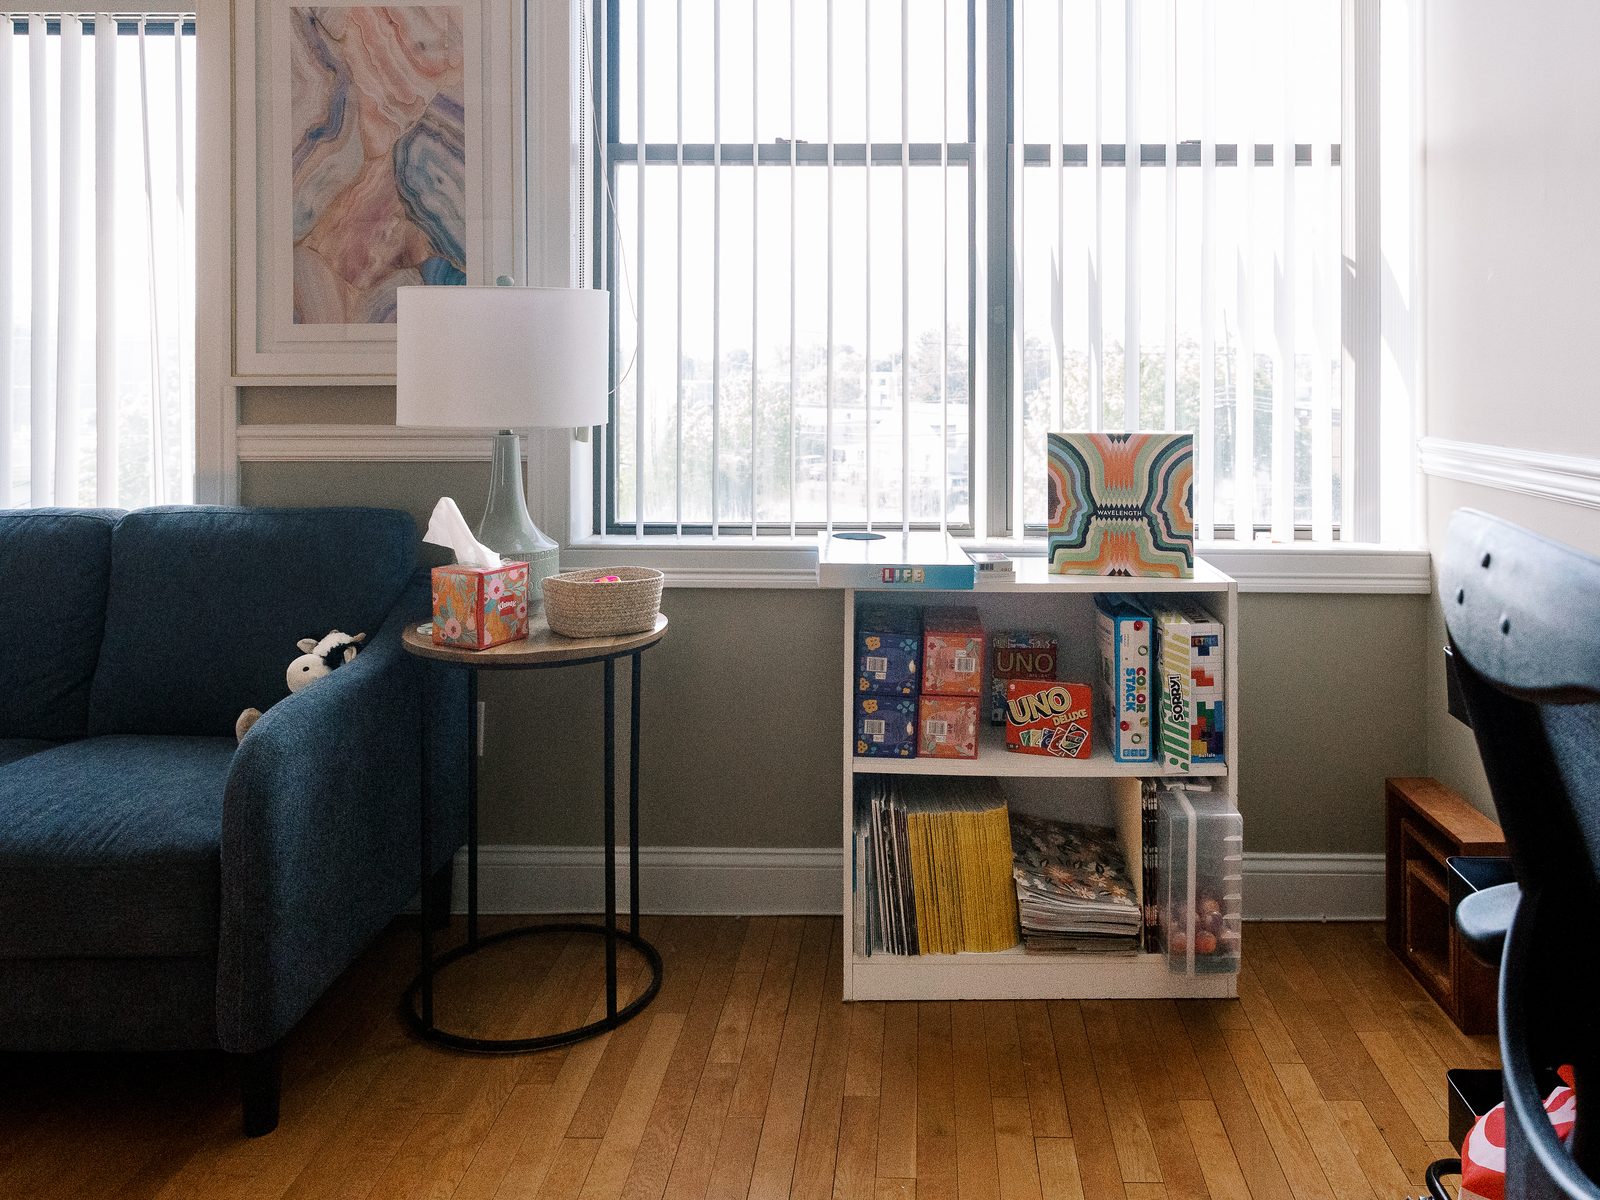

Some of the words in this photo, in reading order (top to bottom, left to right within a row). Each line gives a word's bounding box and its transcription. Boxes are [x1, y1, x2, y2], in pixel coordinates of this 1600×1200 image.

[1097, 509, 1142, 517] WAVELENGTH
[882, 568, 925, 583] LIFE
[996, 651, 1054, 673] UNO
[1125, 668, 1136, 712] STACK
[1136, 667, 1147, 713] COLOR
[1168, 674, 1184, 721] SORRY!
[1007, 687, 1071, 726] UNO
[1052, 708, 1088, 726] DELUXE
